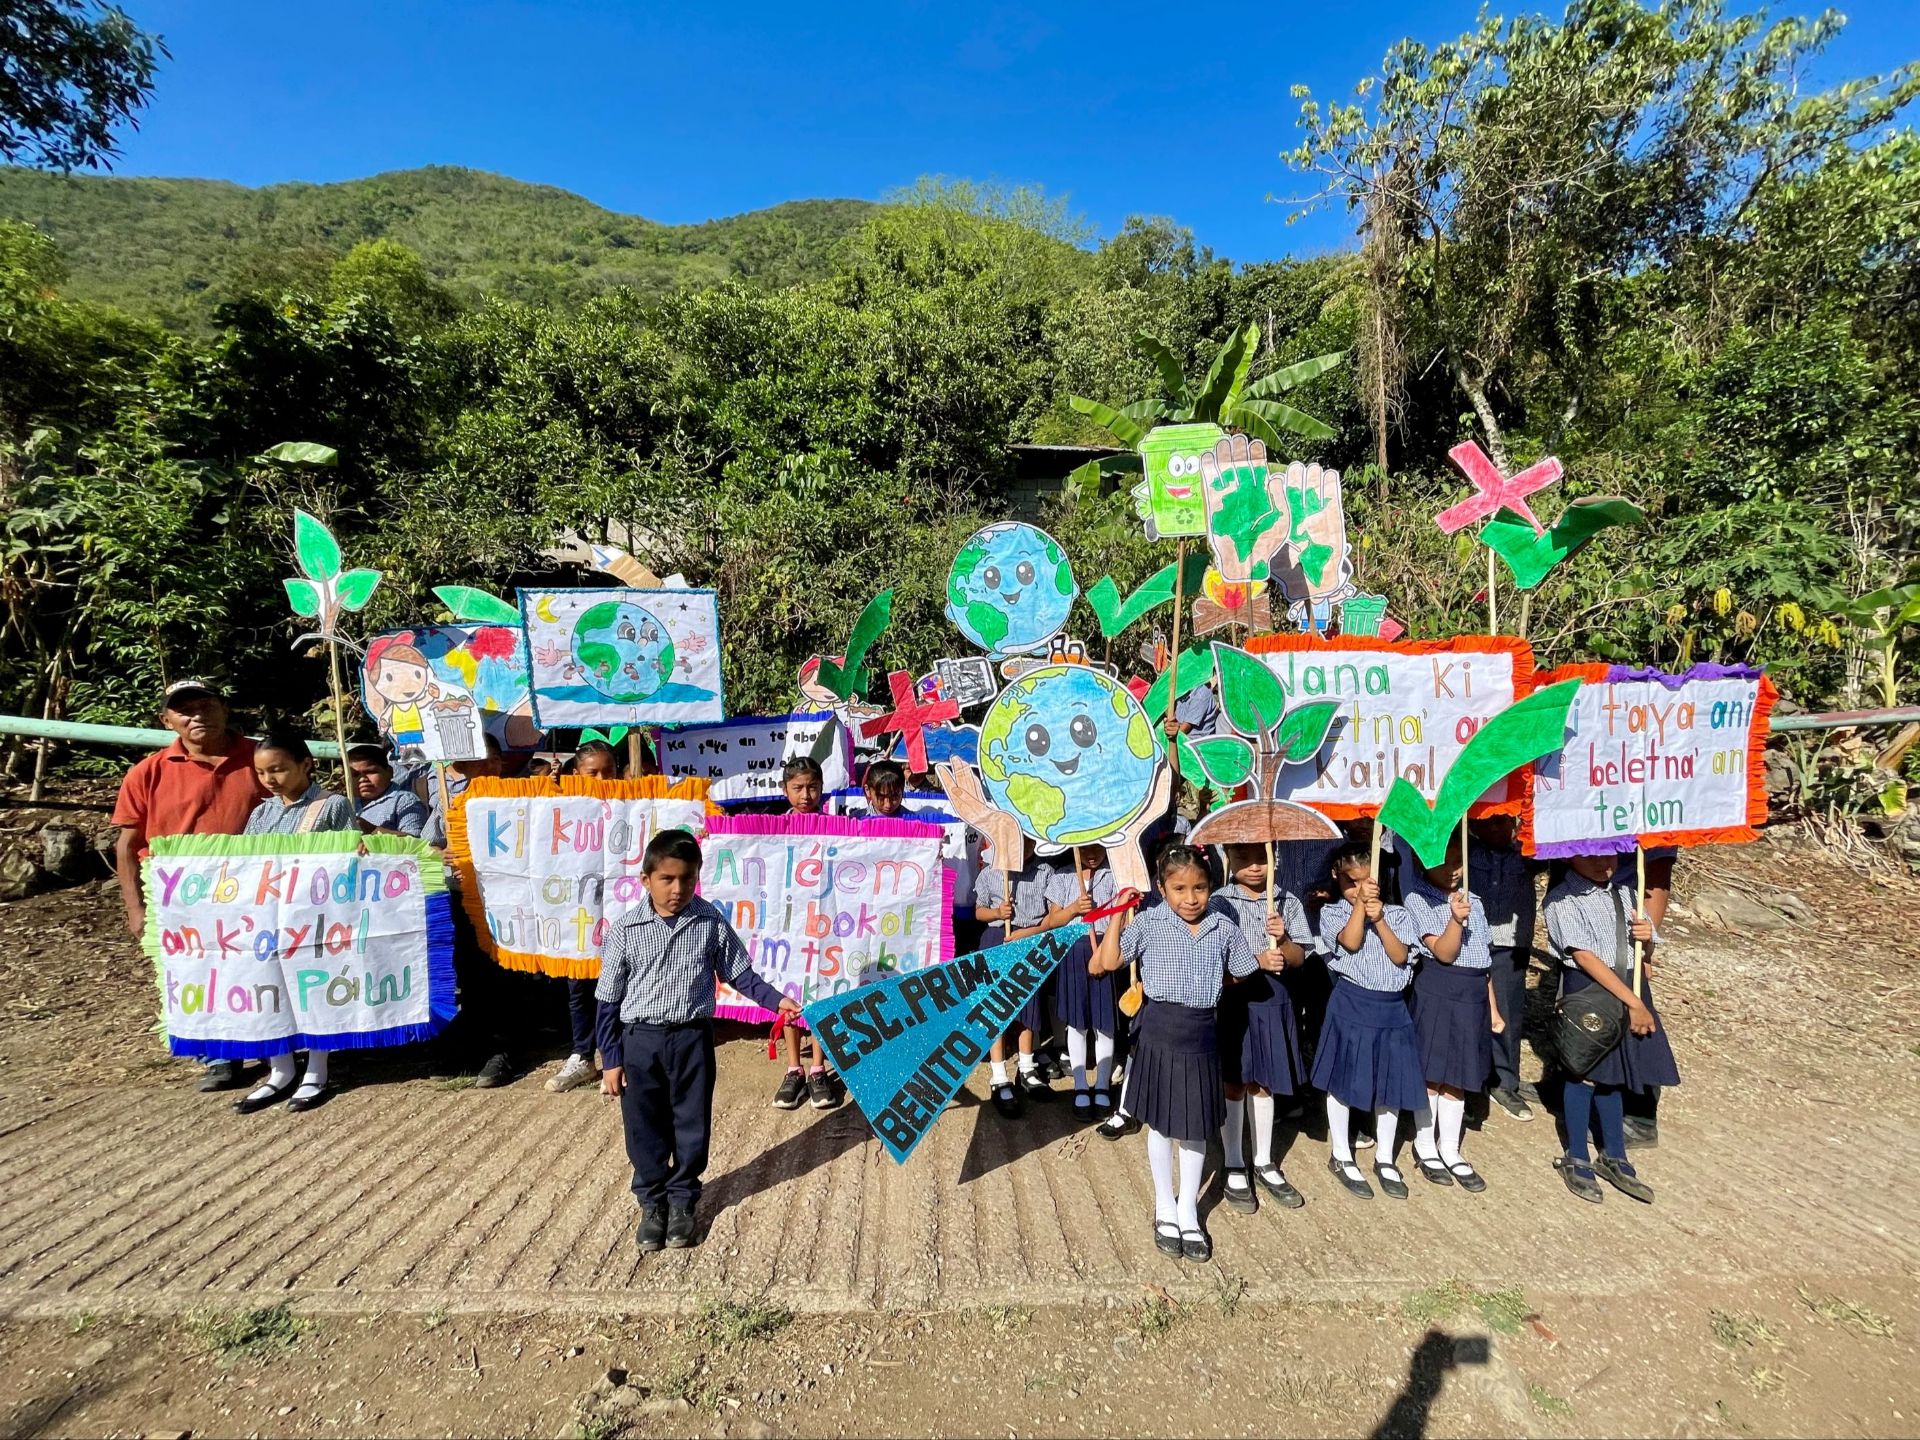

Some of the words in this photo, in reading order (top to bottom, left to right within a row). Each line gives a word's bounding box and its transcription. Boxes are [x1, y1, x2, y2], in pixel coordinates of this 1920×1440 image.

[1711, 691, 1757, 730] ani
[739, 737, 756, 747] an
[748, 757, 775, 769] way
[1713, 749, 1744, 775] an
[157, 861, 239, 907] Yab
[542, 872, 604, 905] an
[712, 849, 767, 886] An
[786, 842, 925, 899] léjem
[783, 895, 792, 932] i
[805, 902, 914, 939] bokol
[162, 925, 204, 959] an
[801, 940, 932, 978] tsabal
[872, 1030, 982, 1152] BENITO
[965, 932, 1068, 1041] JUAREZ
